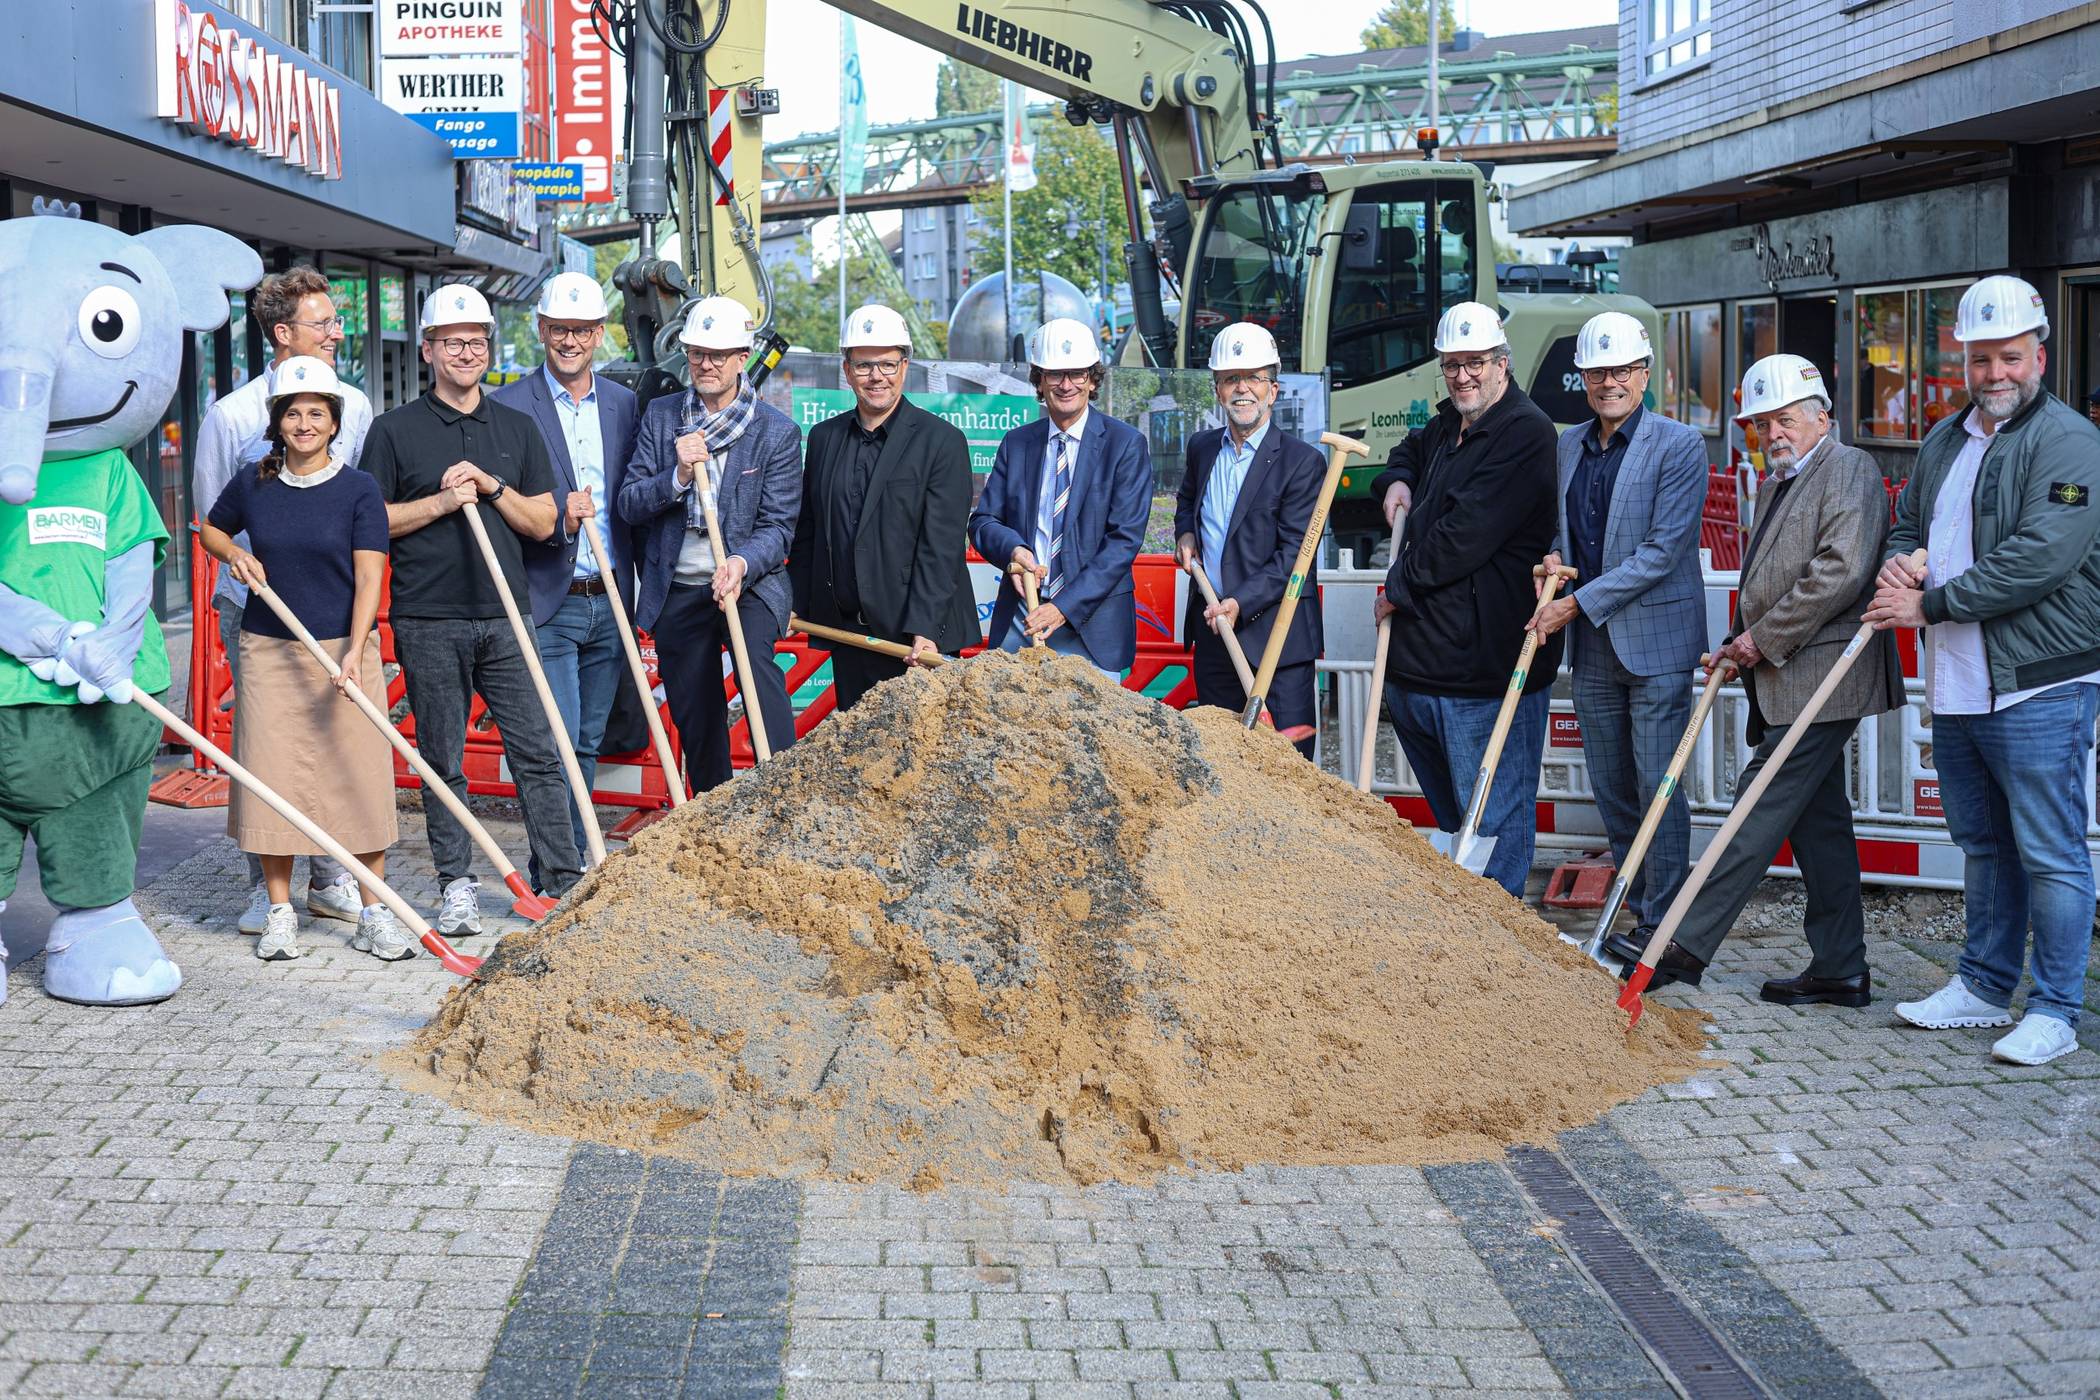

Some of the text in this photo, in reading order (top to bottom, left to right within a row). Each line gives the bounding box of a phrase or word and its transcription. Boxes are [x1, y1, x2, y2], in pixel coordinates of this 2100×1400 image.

[396, 2, 502, 19] PINGUIN
[398, 25, 503, 39] APOTHEKE
[956, 2, 1093, 84] LIEBHERR
[172, 0, 342, 181] ROSSMANN
[398, 74, 504, 98] WERTHER
[435, 119, 485, 133] Fango
[449, 138, 498, 151] ssage
[801, 402, 844, 425] Hie
[1371, 409, 1430, 428] Leonhards
[35, 512, 101, 531] BARMEN
[1301, 508, 1325, 558] Idealspaten
